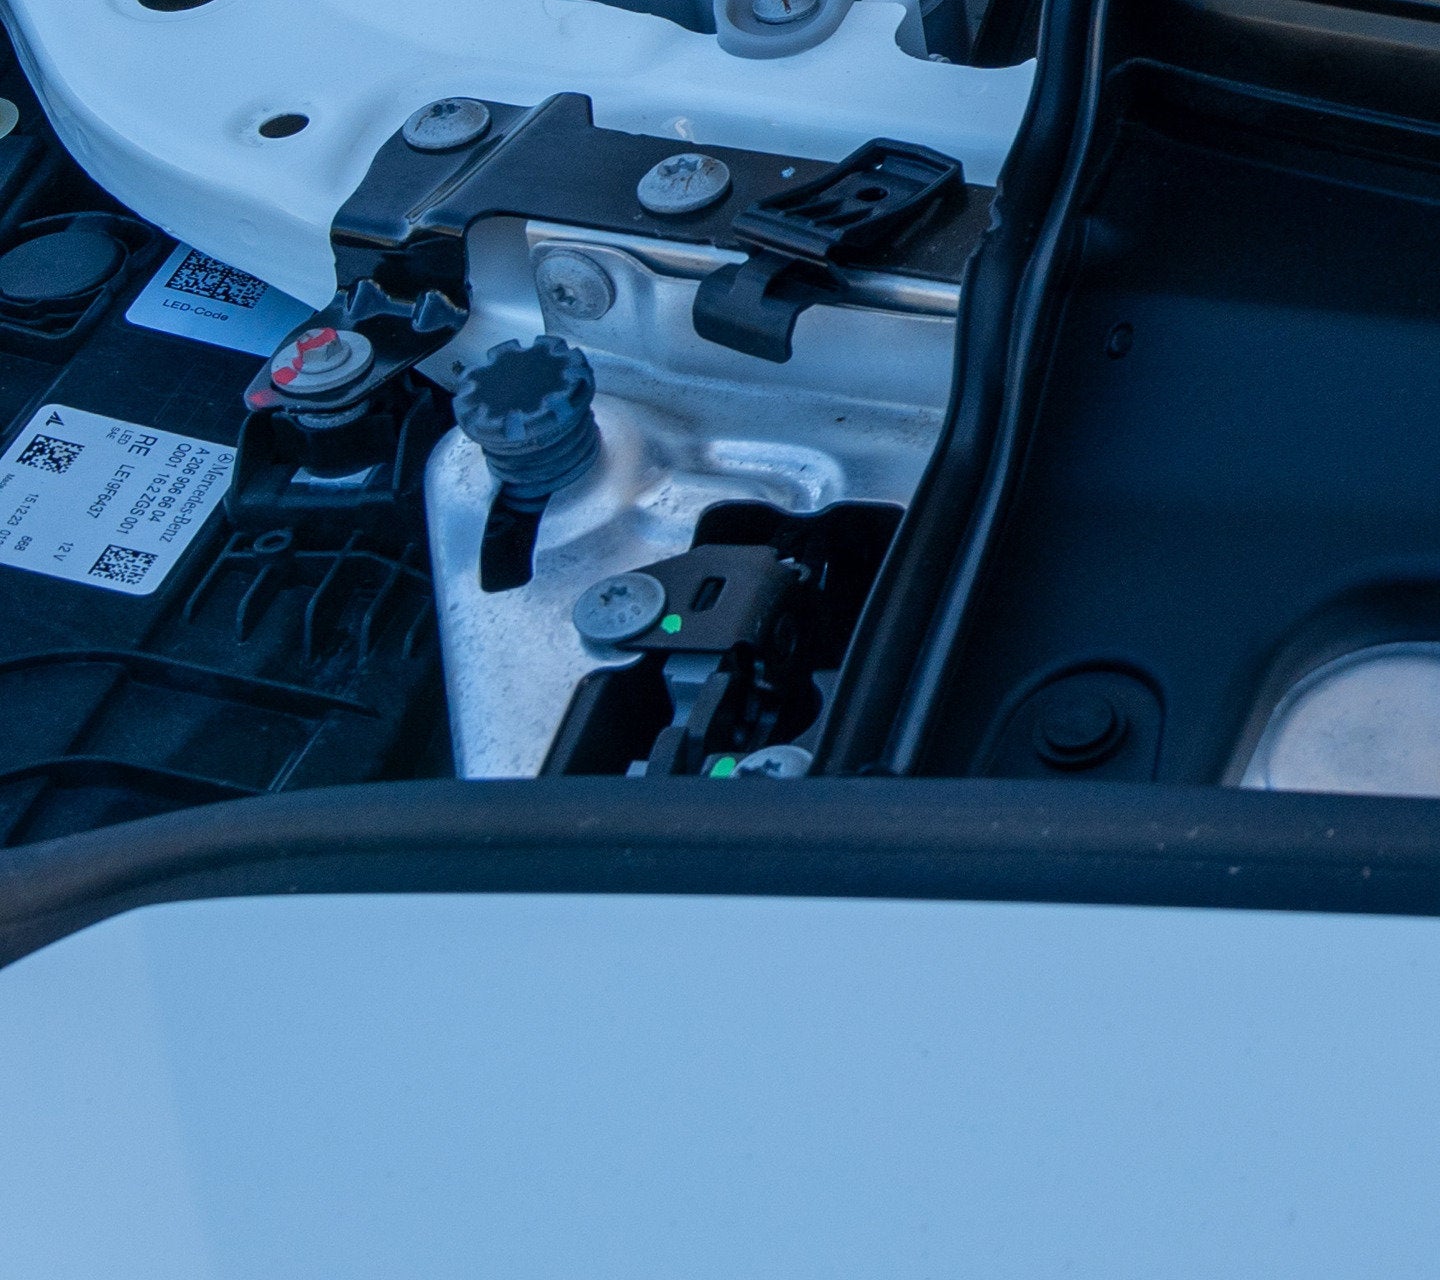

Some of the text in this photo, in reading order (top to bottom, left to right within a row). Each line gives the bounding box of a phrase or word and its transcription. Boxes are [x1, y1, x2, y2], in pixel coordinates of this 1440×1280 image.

[163, 297, 229, 322] LED-Code
[116, 428, 134, 445] LED
[86, 433, 158, 519] RE LE19F6437
[115, 442, 192, 535] Q001 16.2 ZGS 001
[147, 446, 211, 523] A 206 906 66 04
[160, 461, 228, 542] Mercedes-Benz
[7, 493, 39, 526] 15.12.23
[51, 541, 74, 562] 12 V
